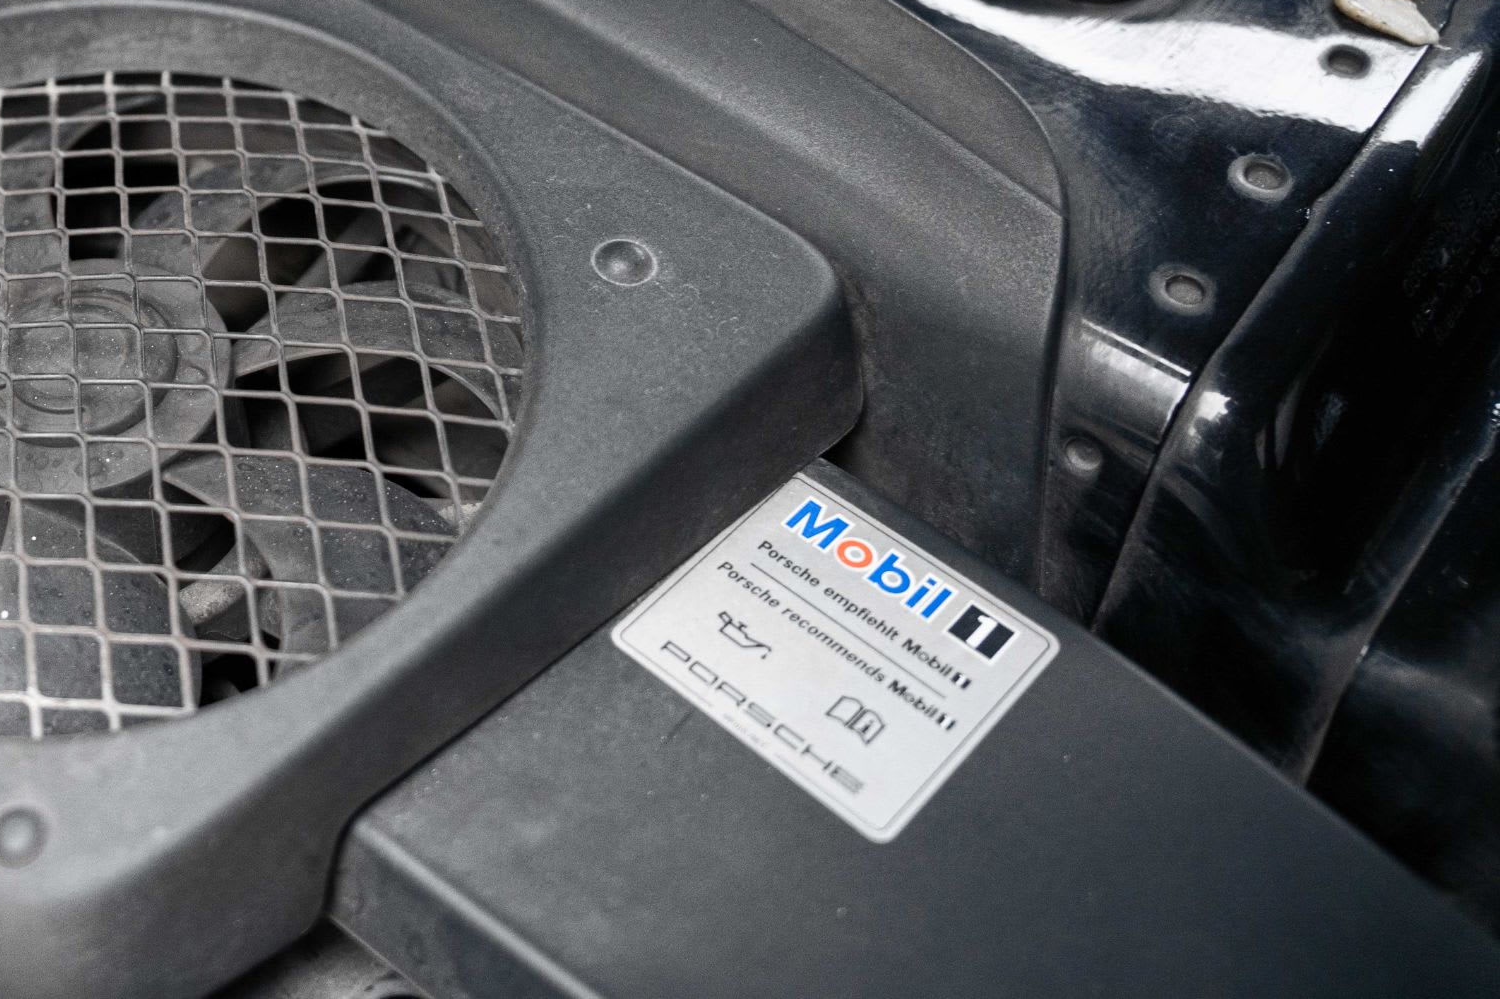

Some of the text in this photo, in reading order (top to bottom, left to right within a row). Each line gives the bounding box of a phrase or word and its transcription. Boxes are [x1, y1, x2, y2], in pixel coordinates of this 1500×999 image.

[757, 540, 820, 588] Porsche
[823, 586, 900, 641] empfiehlt
[786, 501, 953, 619] Mobil
[716, 561, 780, 608] Porsche
[781, 607, 886, 683] recommends
[660, 640, 865, 795] PORSCHE
